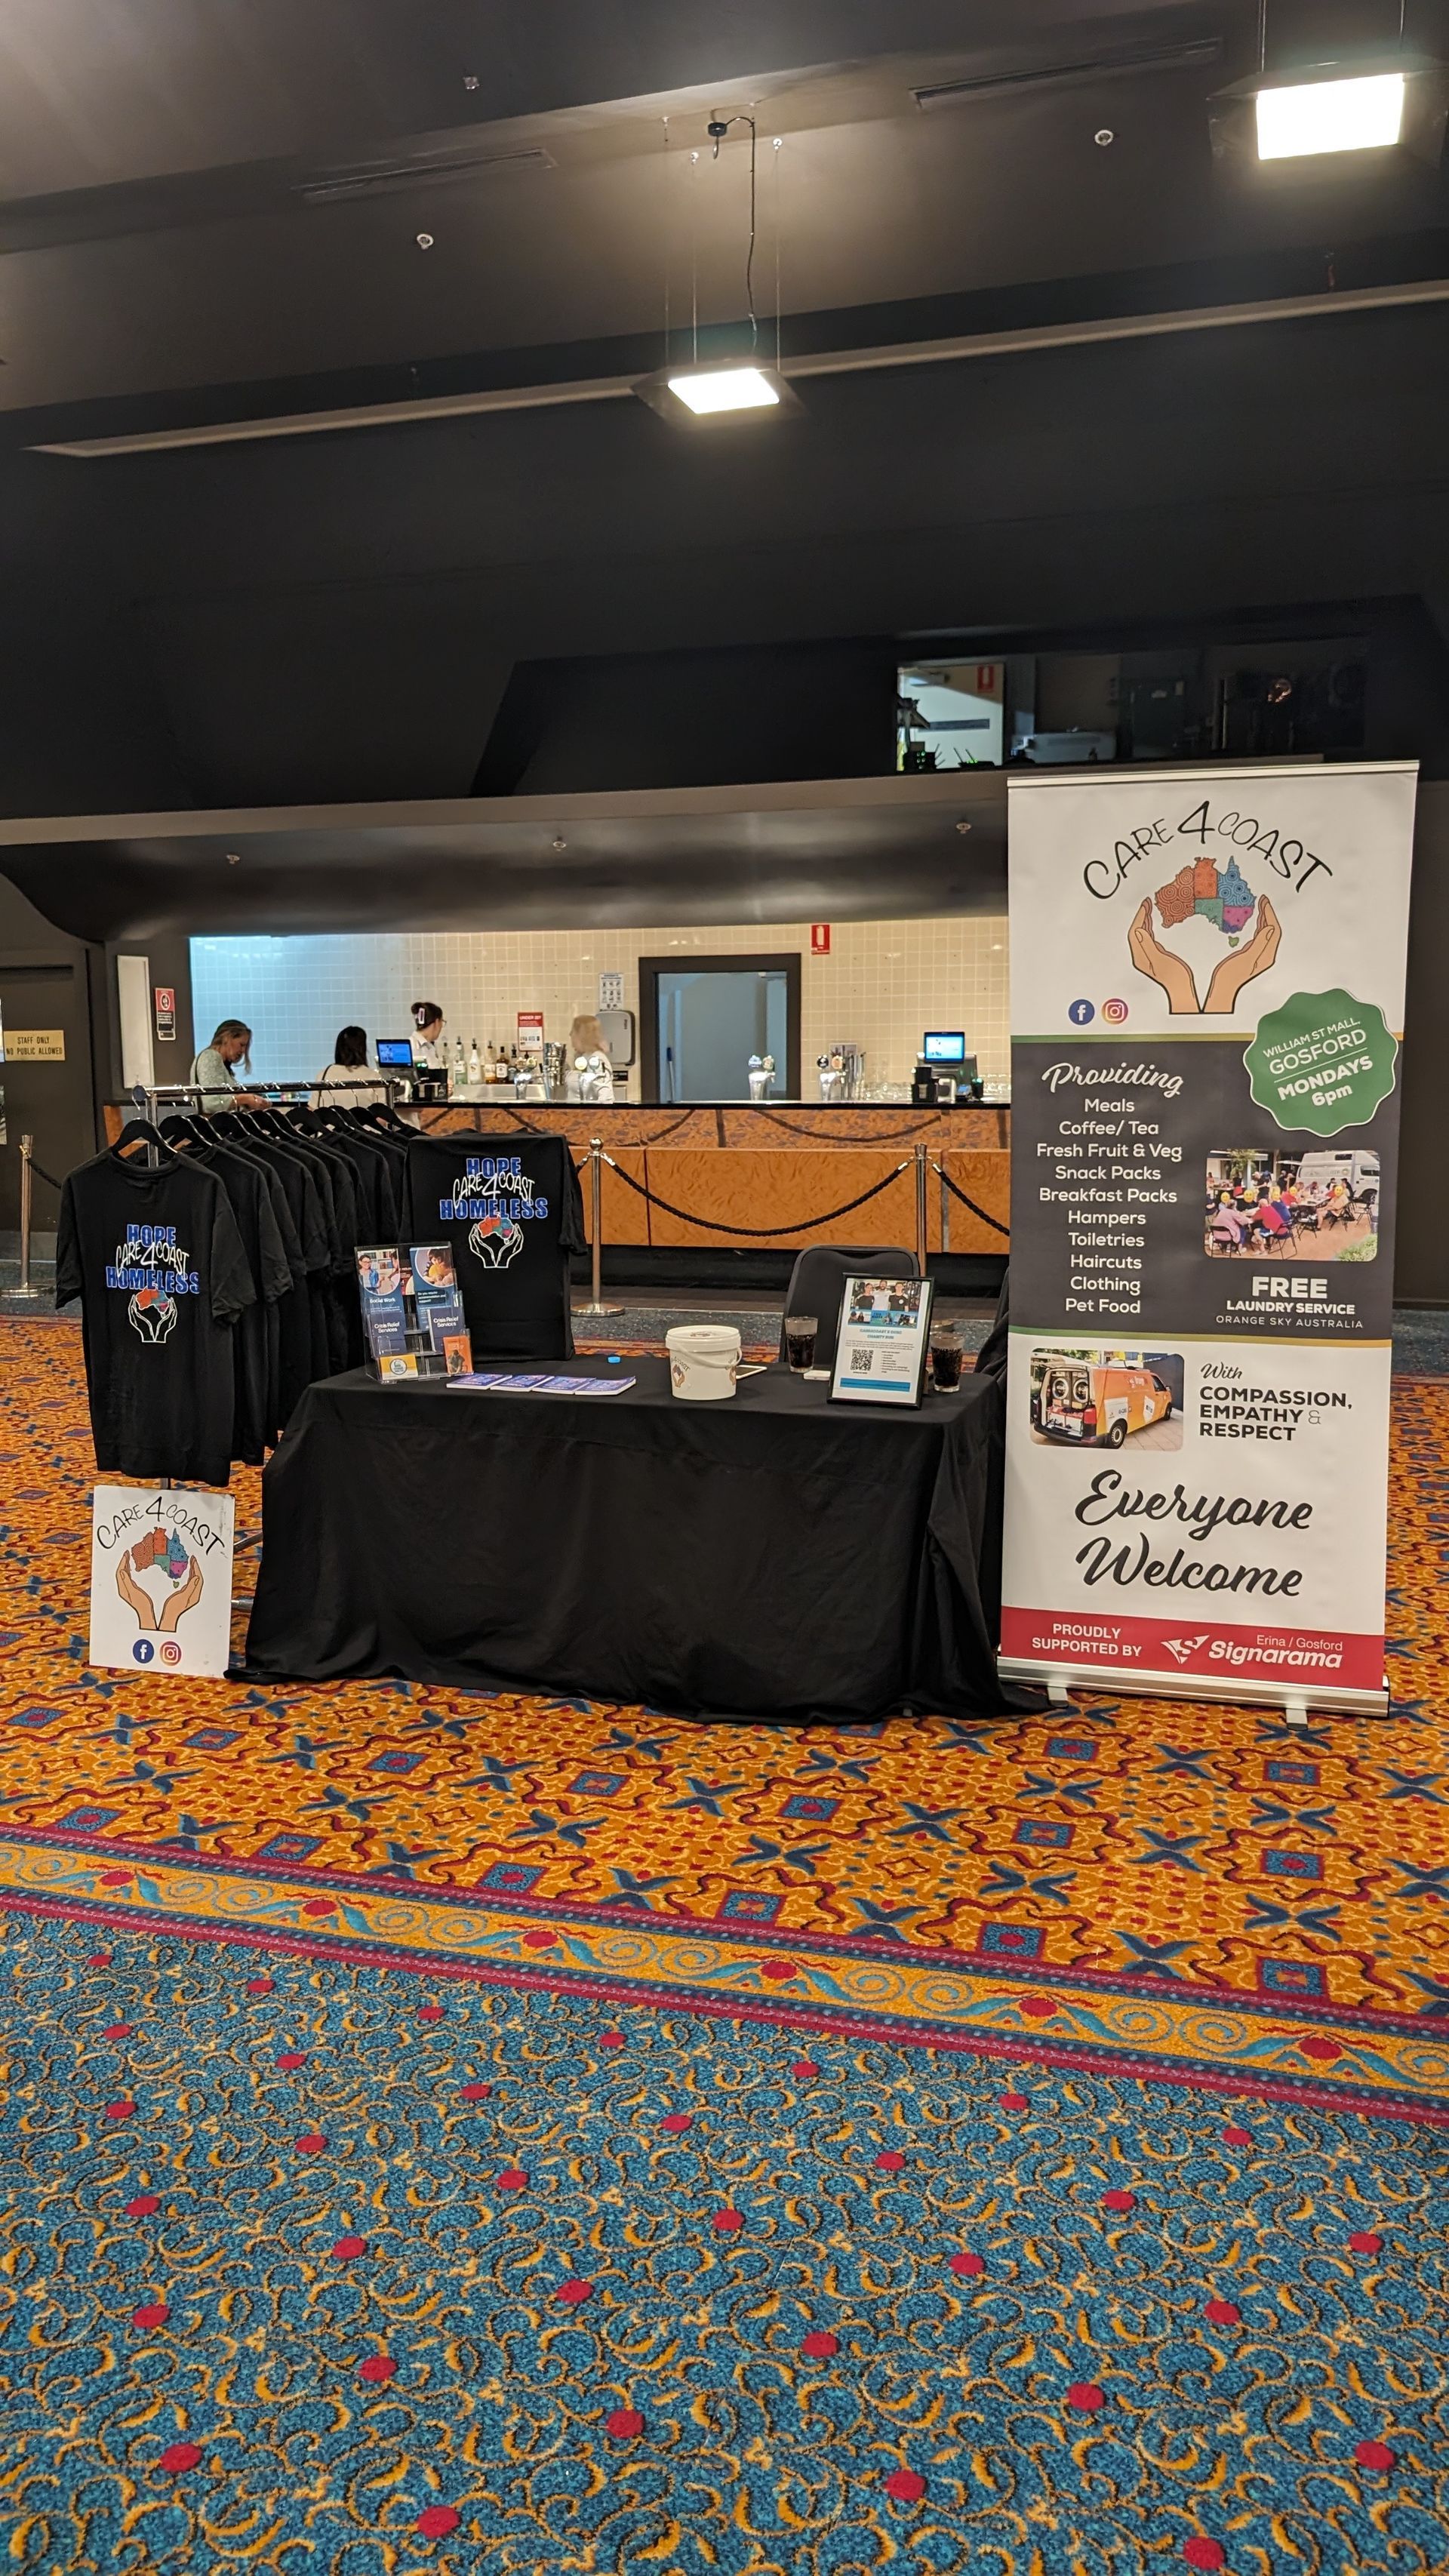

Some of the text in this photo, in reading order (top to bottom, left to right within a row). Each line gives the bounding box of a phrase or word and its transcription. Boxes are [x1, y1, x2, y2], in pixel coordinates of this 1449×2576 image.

[17, 1036, 33, 1045] STAFF
[1263, 1034, 1311, 1057] WILLIAM
[1312, 1029, 1327, 1041] ST
[1269, 1029, 1367, 1075] GOSFORD
[1041, 1062, 1183, 1098] Providing
[1277, 1056, 1373, 1100] MONDAYS
[1084, 1098, 1135, 1113] Meals
[1312, 1085, 1352, 1106] 6pm
[1059, 1120, 1159, 1136] Coffee/ Tea
[1037, 1143, 1182, 1162] Fresh Fruit & Veg
[466, 1157, 521, 1179] HOPE
[1055, 1165, 1161, 1180] Snack Packs
[1039, 1187, 1177, 1202] Breakfast Packs
[439, 1198, 548, 1220] HOMELESS
[1068, 1210, 1146, 1228] Hampers
[126, 1223, 177, 1248] HOPE
[1068, 1232, 1145, 1247] Toiletries
[1070, 1254, 1142, 1270] Haircuts
[105, 1266, 200, 1294] HOMELESS
[1070, 1276, 1141, 1296] Clothing
[1251, 1276, 1327, 1299] FREE
[1065, 1298, 1141, 1313] Pet Food
[1226, 1300, 1355, 1315] LAUNDRY SERVICE
[1216, 1316, 1363, 1328] ORANGE SKY AUSTRALIA
[1201, 1362, 1242, 1380] With
[1200, 1386, 1352, 1409] COMPASSION,
[1200, 1404, 1321, 1424] EMPATHY &
[1199, 1422, 1297, 1441] RESPECT
[1074, 1469, 1313, 1540] Everyone
[1075, 1533, 1303, 1597] Welcome
[1053, 1623, 1121, 1639] PROUDLY
[1032, 1637, 1142, 1657] SUPPORTED BY
[1257, 1634, 1286, 1647] Erina
[1296, 1637, 1343, 1651] Gosford
[1208, 1640, 1343, 1668] Signarama
